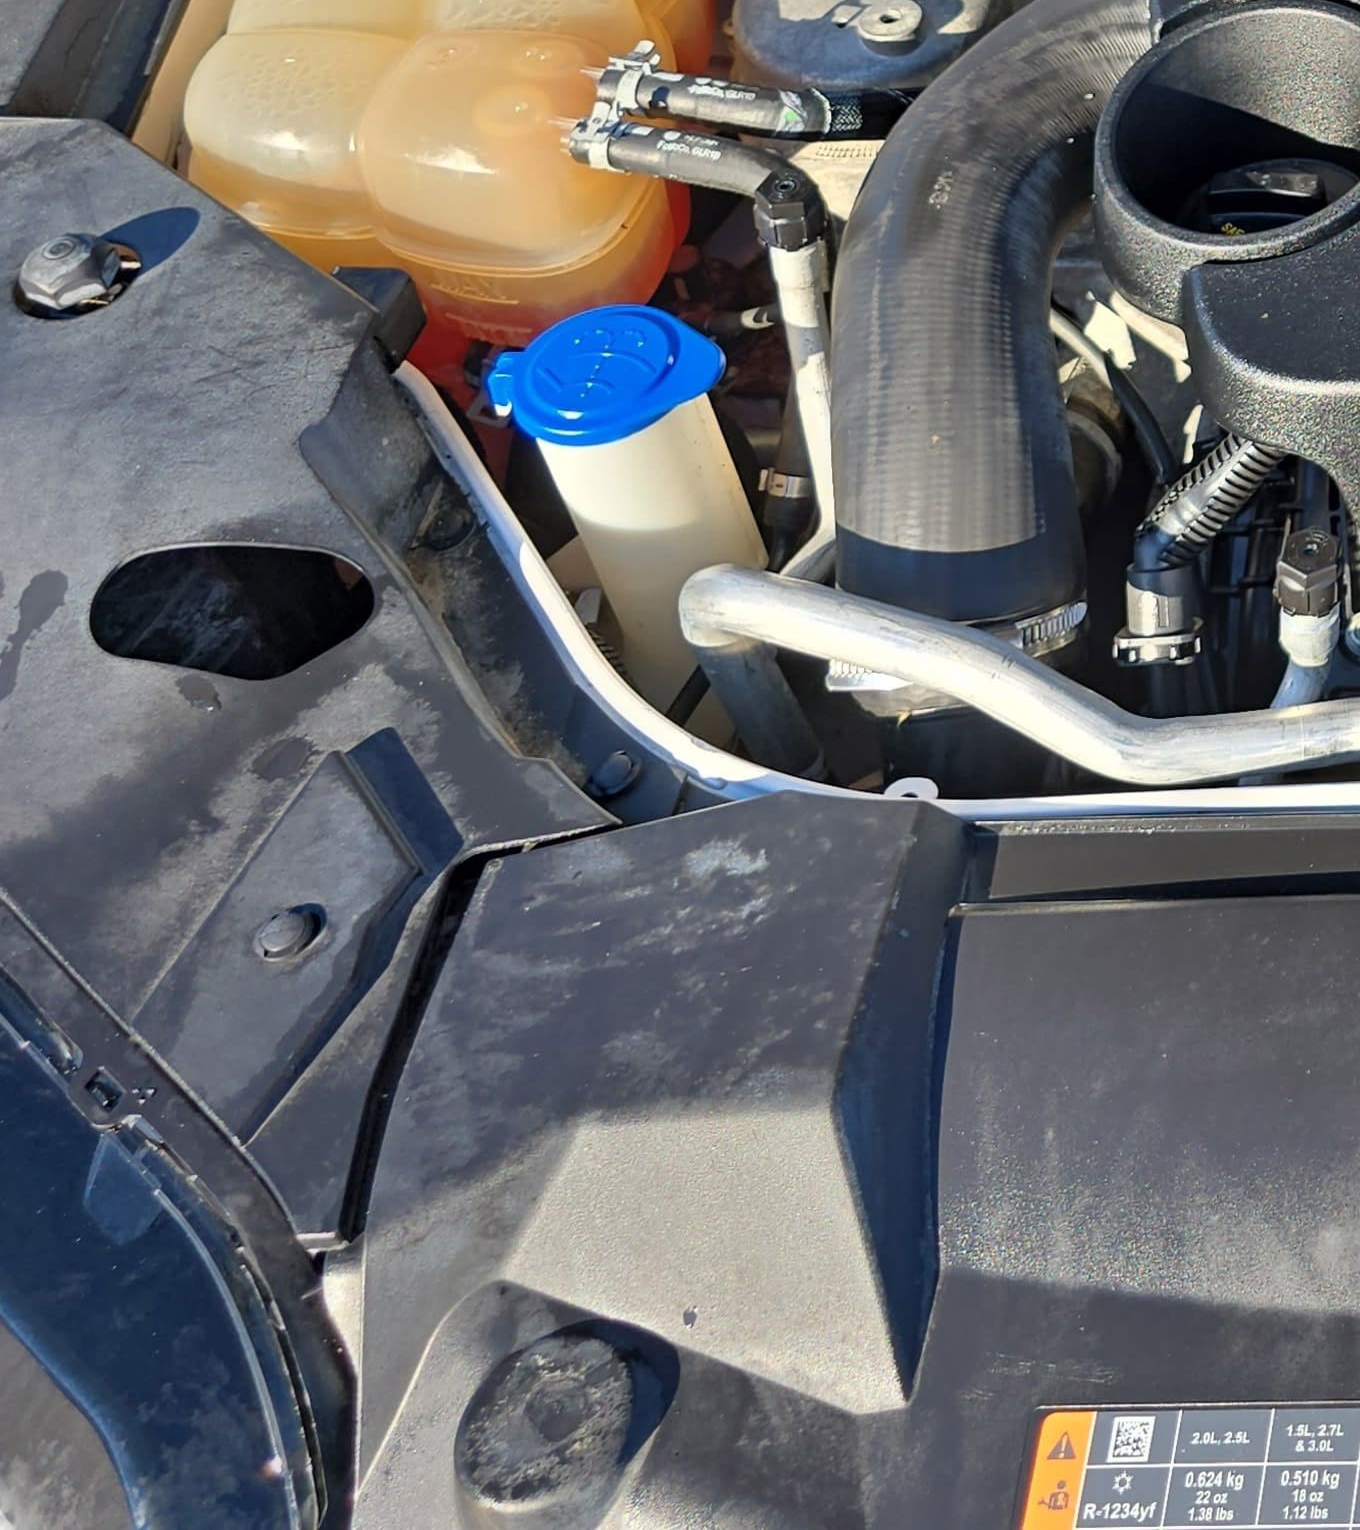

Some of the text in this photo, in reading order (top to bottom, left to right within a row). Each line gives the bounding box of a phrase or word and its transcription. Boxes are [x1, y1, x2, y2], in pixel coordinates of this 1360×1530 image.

[1286, 1423, 1344, 1438] 1.5L, 2.7L
[1191, 1431, 1250, 1445] 2.0L, 2.5L
[1295, 1440, 1334, 1452] & 3.0L
[1184, 1470, 1244, 1491] 0.624 kg
[1280, 1470, 1340, 1490] 0.510 kg
[1195, 1491, 1228, 1505] 22 oz
[1292, 1489, 1324, 1503] 18 oz
[1083, 1502, 1157, 1523] R-1234yf
[1187, 1507, 1234, 1521] 1.38 lbs
[1283, 1505, 1328, 1520] 1.12 lbs
